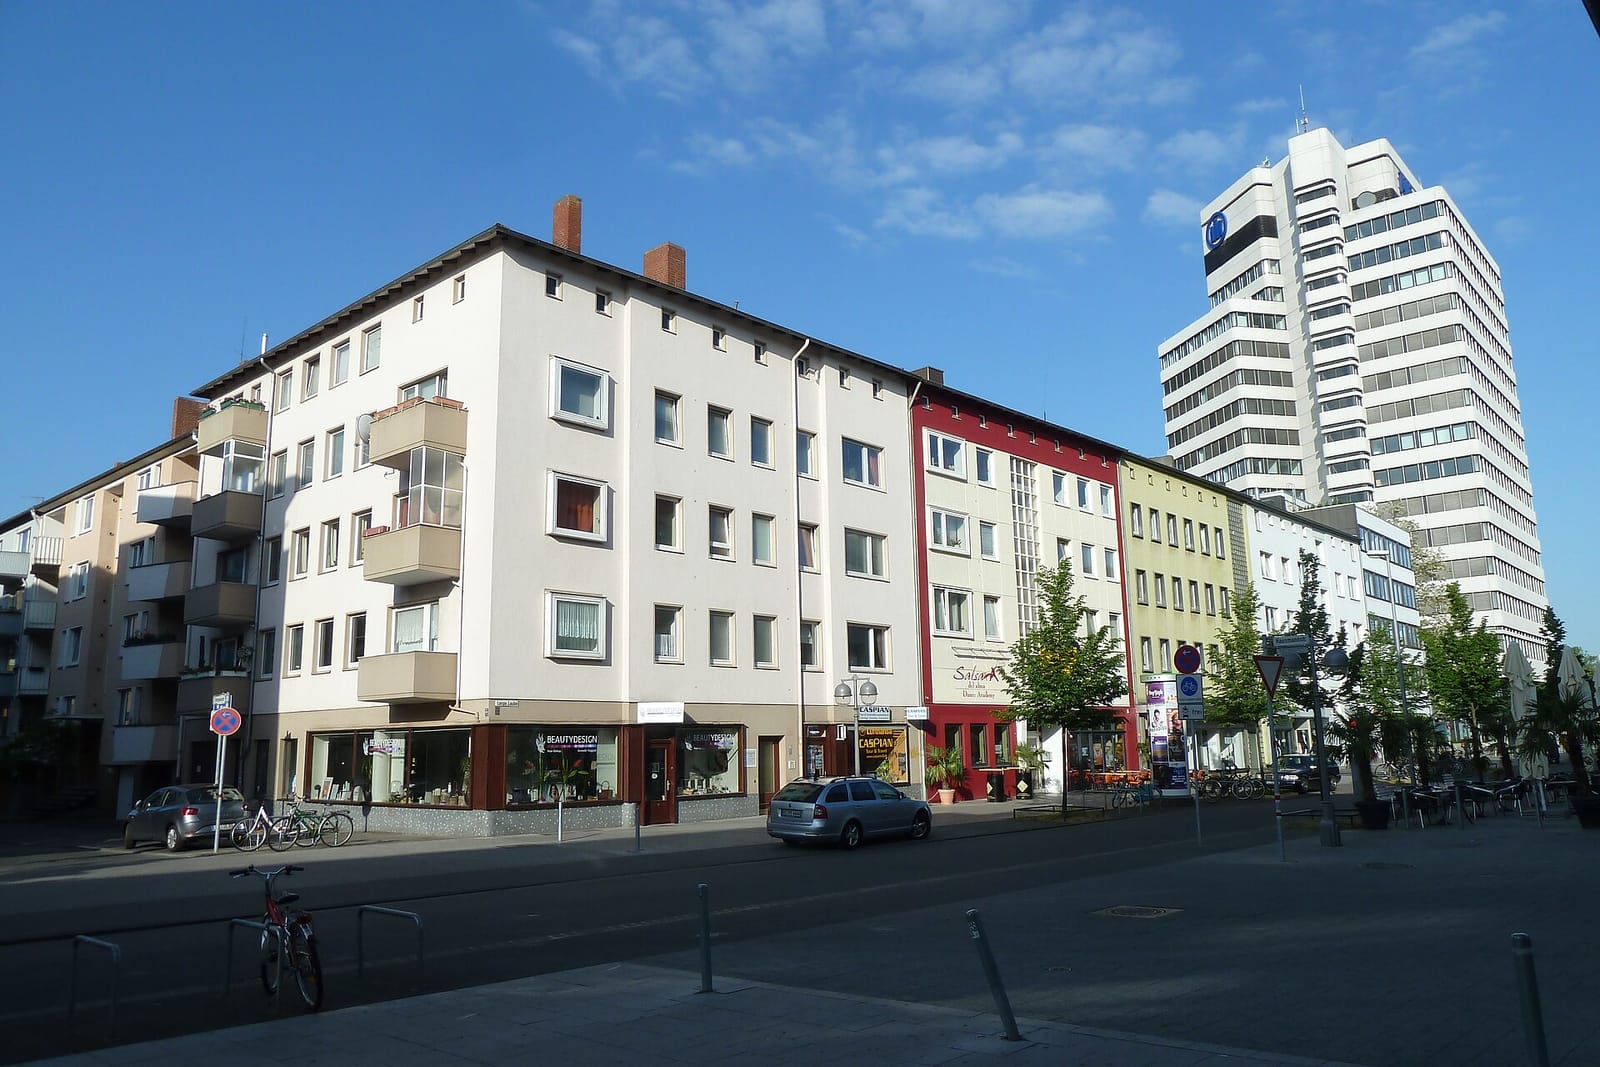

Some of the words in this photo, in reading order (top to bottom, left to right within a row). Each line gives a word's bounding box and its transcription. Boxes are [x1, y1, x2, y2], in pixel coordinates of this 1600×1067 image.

[953, 665, 985, 681] Salsa
[547, 735, 598, 744] BEAUTYDESIGN
[859, 738, 893, 748] CASPIAN
